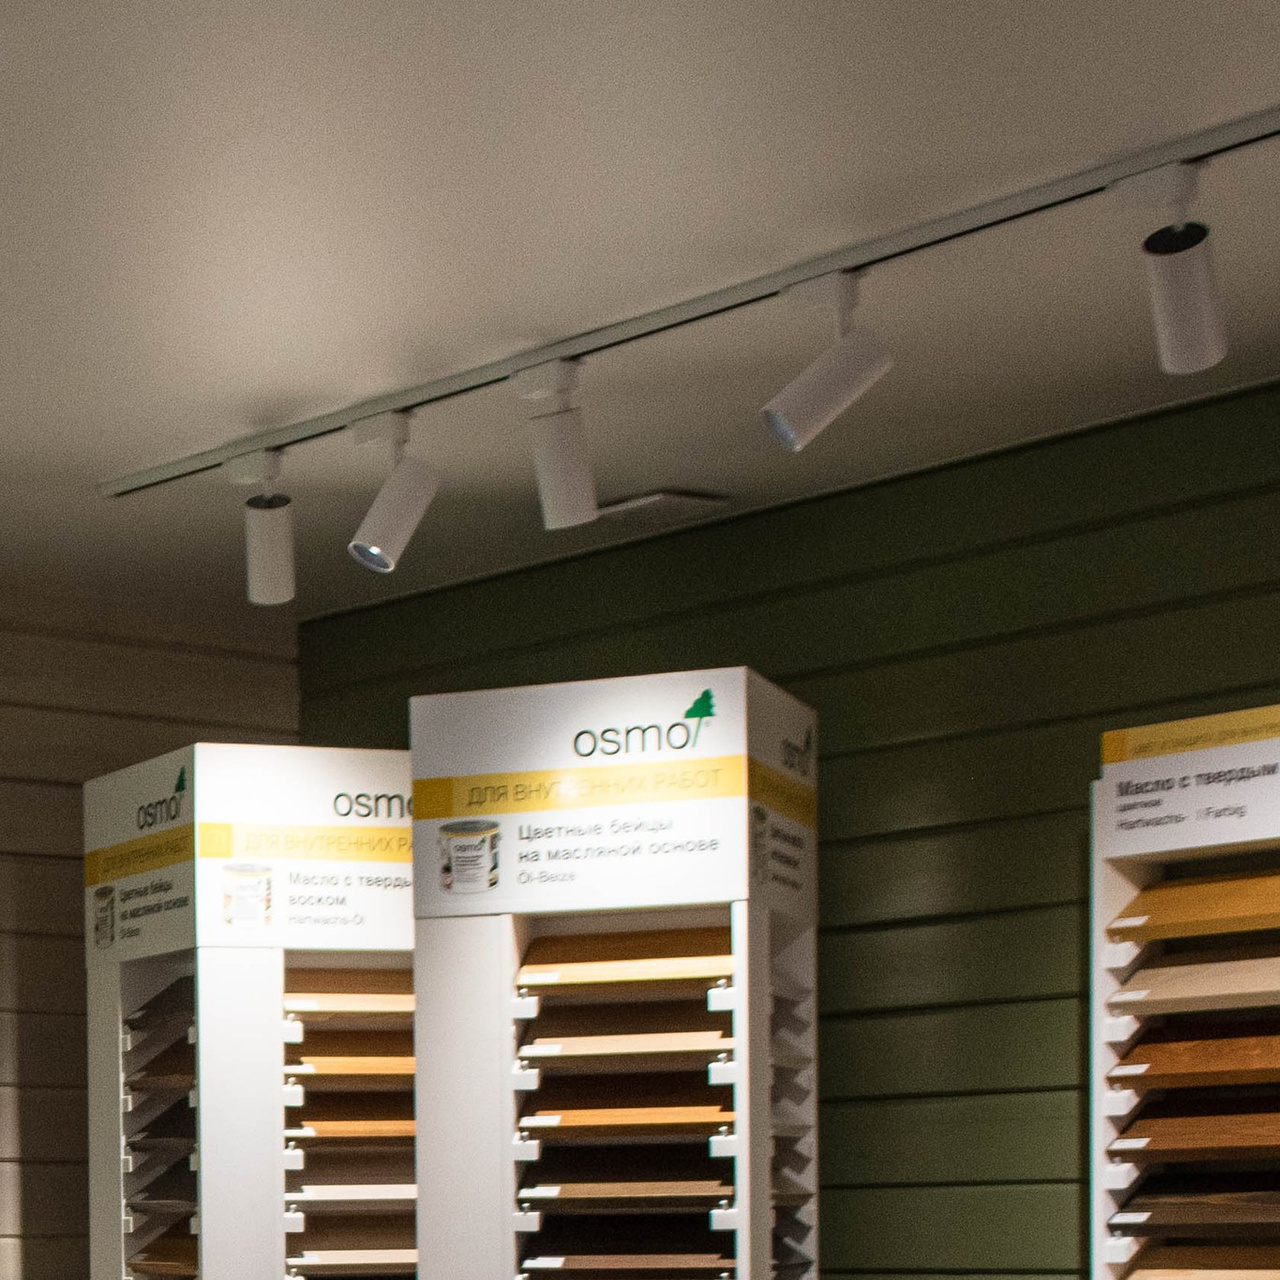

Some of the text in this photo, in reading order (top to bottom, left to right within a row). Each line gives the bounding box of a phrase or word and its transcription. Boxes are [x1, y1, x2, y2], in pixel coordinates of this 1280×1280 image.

[573, 721, 691, 758] osmo
[467, 784, 509, 807] ДЛЯ
[1116, 777, 1176, 797] Масло
[136, 795, 182, 830] osmo
[518, 817, 673, 842] Цветные бейцы
[517, 836, 720, 864] на масляной основе
[288, 872, 340, 886] Масло
[288, 894, 347, 907] воском
